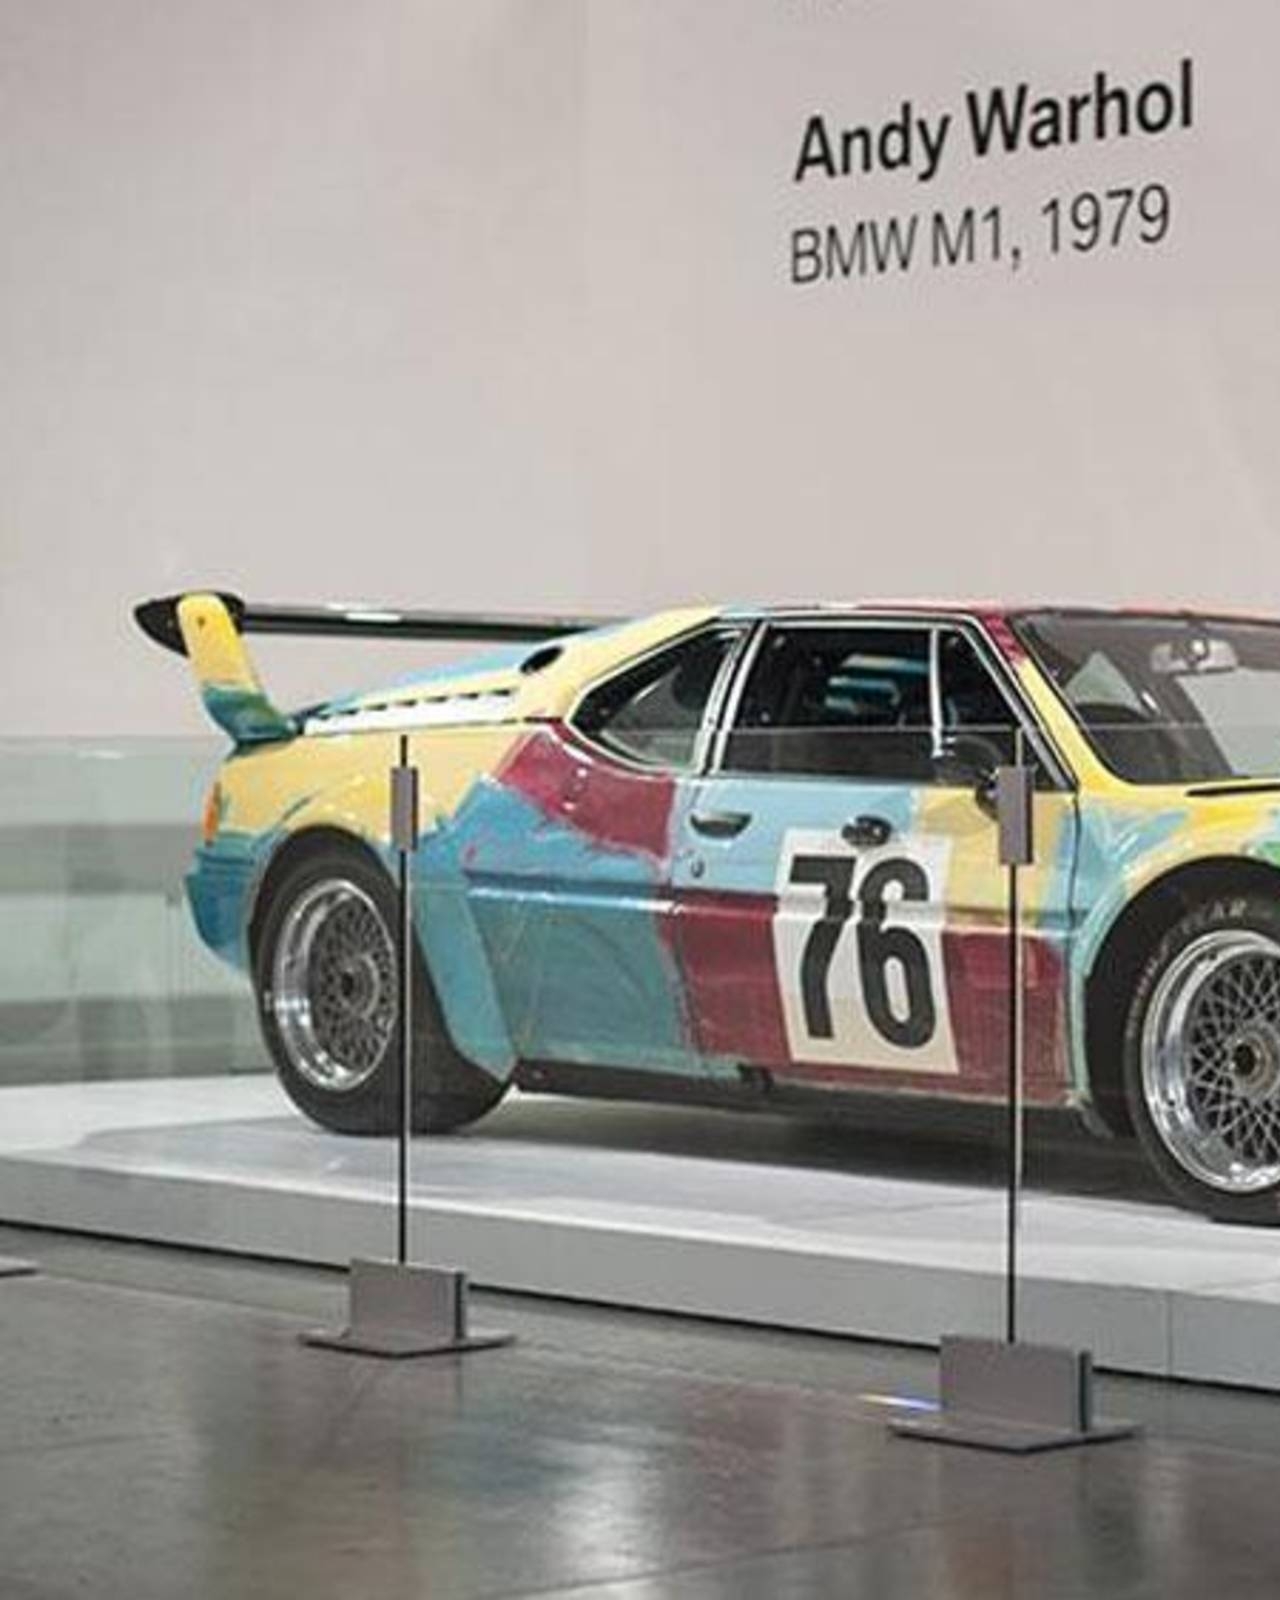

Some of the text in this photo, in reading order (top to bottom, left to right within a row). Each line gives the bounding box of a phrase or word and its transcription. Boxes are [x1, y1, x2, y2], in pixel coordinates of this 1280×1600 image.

[794, 57, 1193, 182] Andy Warhol
[790, 183, 1170, 285] BMW M1, 1979
[789, 856, 936, 1049] 76
